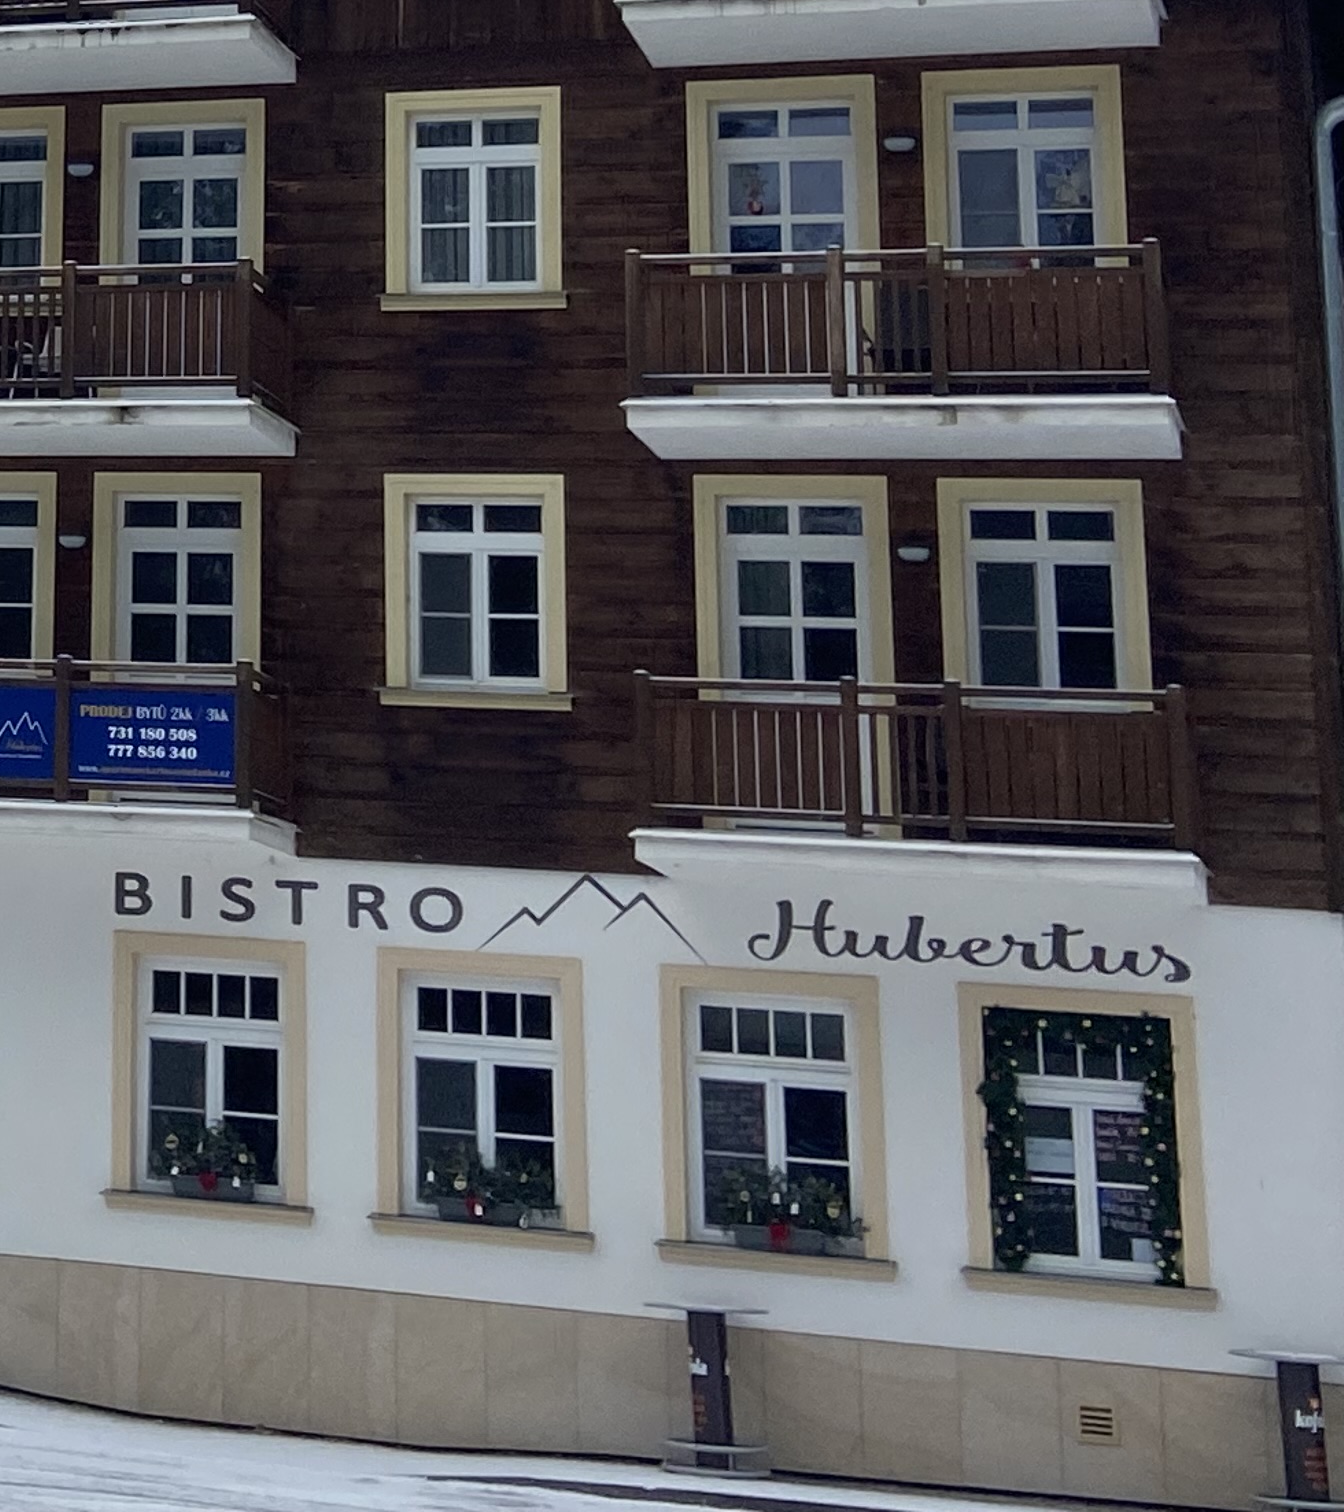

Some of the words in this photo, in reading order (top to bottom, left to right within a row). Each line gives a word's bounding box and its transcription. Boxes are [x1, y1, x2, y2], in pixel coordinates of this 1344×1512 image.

[80, 704, 132, 718] PRODEJ
[136, 703, 167, 720] BYTŮ
[108, 726, 133, 740] 731
[139, 727, 165, 741] 180
[168, 728, 197, 742] 508
[107, 745, 133, 758] 777
[137, 746, 166, 759] 856
[169, 746, 198, 760] 340
[114, 871, 464, 934] BISTRO
[747, 898, 1192, 983] Hubertus
